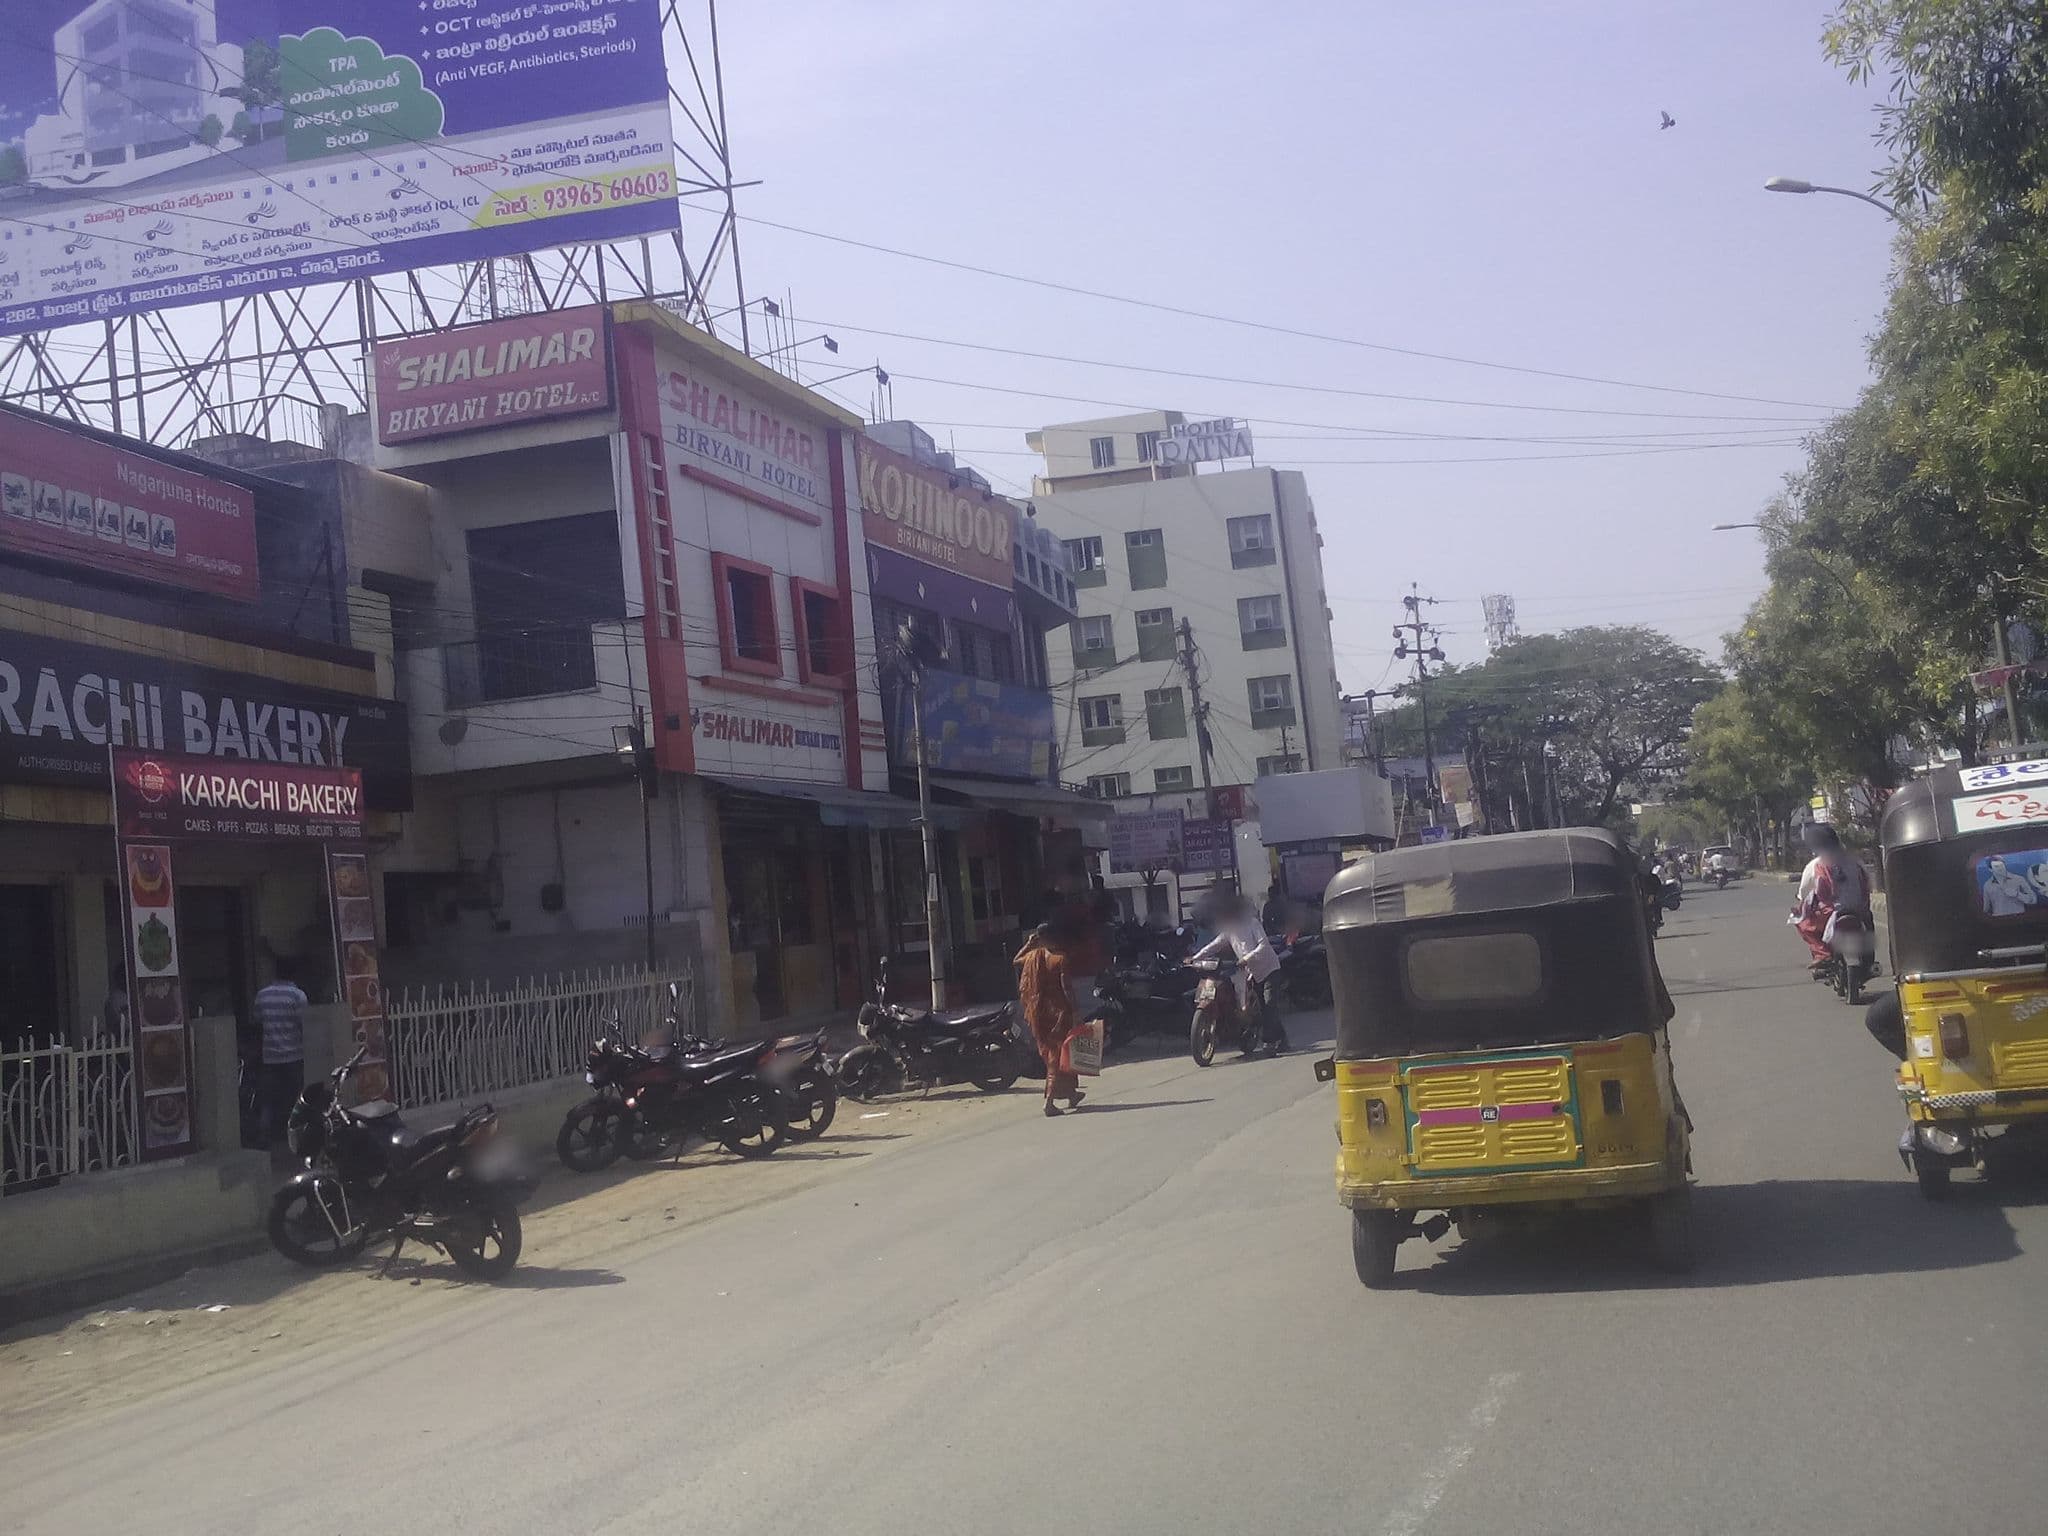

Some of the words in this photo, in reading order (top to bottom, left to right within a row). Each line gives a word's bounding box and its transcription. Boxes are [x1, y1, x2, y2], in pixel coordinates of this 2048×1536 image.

[435, 17, 472, 34] OCT
[329, 55, 358, 73] TPA
[435, 67, 467, 86] (Anti
[470, 61, 507, 77] VEGF,
[509, 50, 579, 71] Antibiotics,
[580, 38, 637, 58] Steriods)
[325, 130, 369, 148] కలదు
[511, 147, 532, 159] మా
[363, 212, 372, 223] &
[463, 195, 480, 206] ICL
[493, 195, 528, 217] సెల్
[543, 183, 603, 211] 93965
[610, 170, 670, 201] 60603
[240, 233, 249, 243] &
[397, 327, 595, 392] SHALIMAR
[387, 396, 488, 435] BIRYANI
[495, 381, 578, 416] HOTEL
[669, 371, 816, 468] SHALIMAR
[1171, 417, 1233, 438] HOTEL
[676, 423, 752, 473] BIRYANI
[761, 460, 816, 498] HOTEL
[1157, 429, 1253, 466] RATNA
[116, 461, 192, 503] Nagarjuna
[196, 487, 241, 518] Honda
[859, 449, 1009, 562] KOHINOOR
[897, 528, 931, 554] BIRYANI
[931, 541, 958, 565] HOTEL
[181, 690, 349, 769] BAKERY
[702, 711, 794, 749] SHALIMAR
[180, 772, 281, 811] KARACHI
[287, 782, 358, 815] BAKERY
[184, 818, 211, 832] CAKES
[217, 820, 240, 833] PUFFS
[245, 822, 269, 834] PIZZAS
[1483, 1110, 1496, 1119] RE
